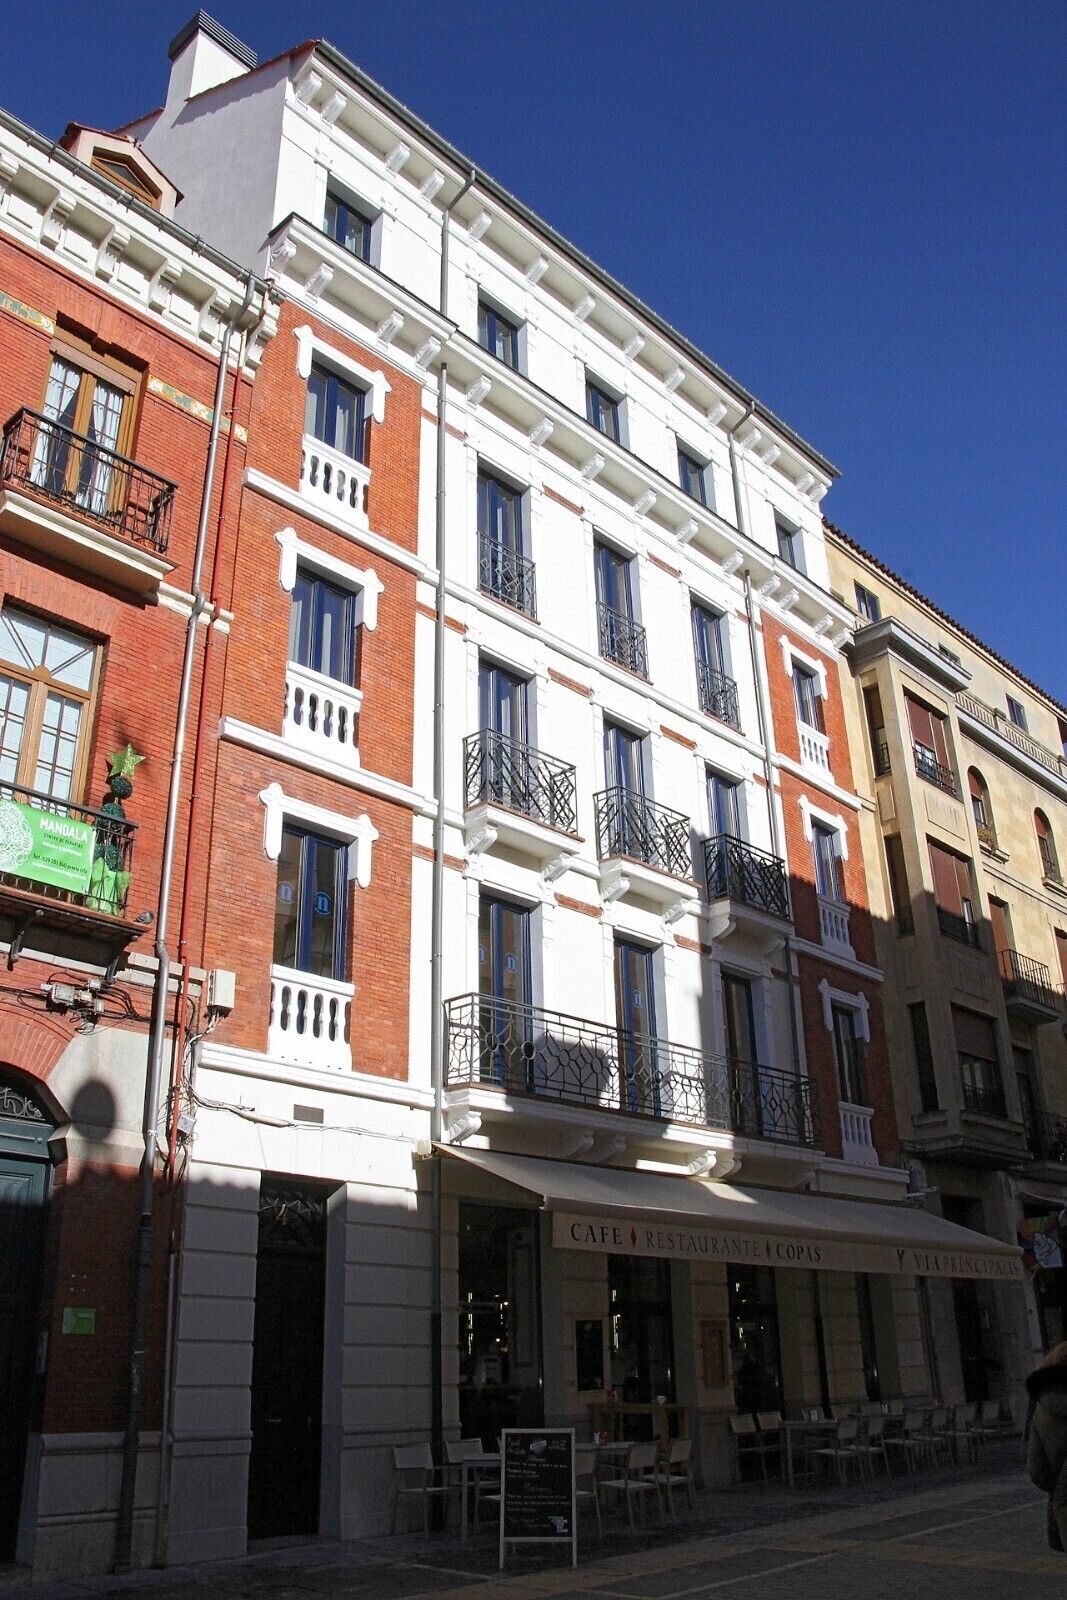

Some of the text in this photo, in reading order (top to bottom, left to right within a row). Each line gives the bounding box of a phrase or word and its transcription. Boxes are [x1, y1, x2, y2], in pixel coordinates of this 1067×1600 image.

[40, 817, 87, 842] MANDALA
[570, 1222, 622, 1245] CAFE
[645, 1231, 762, 1257] RESTAURANTE
[776, 1243, 821, 1262] COPAS
